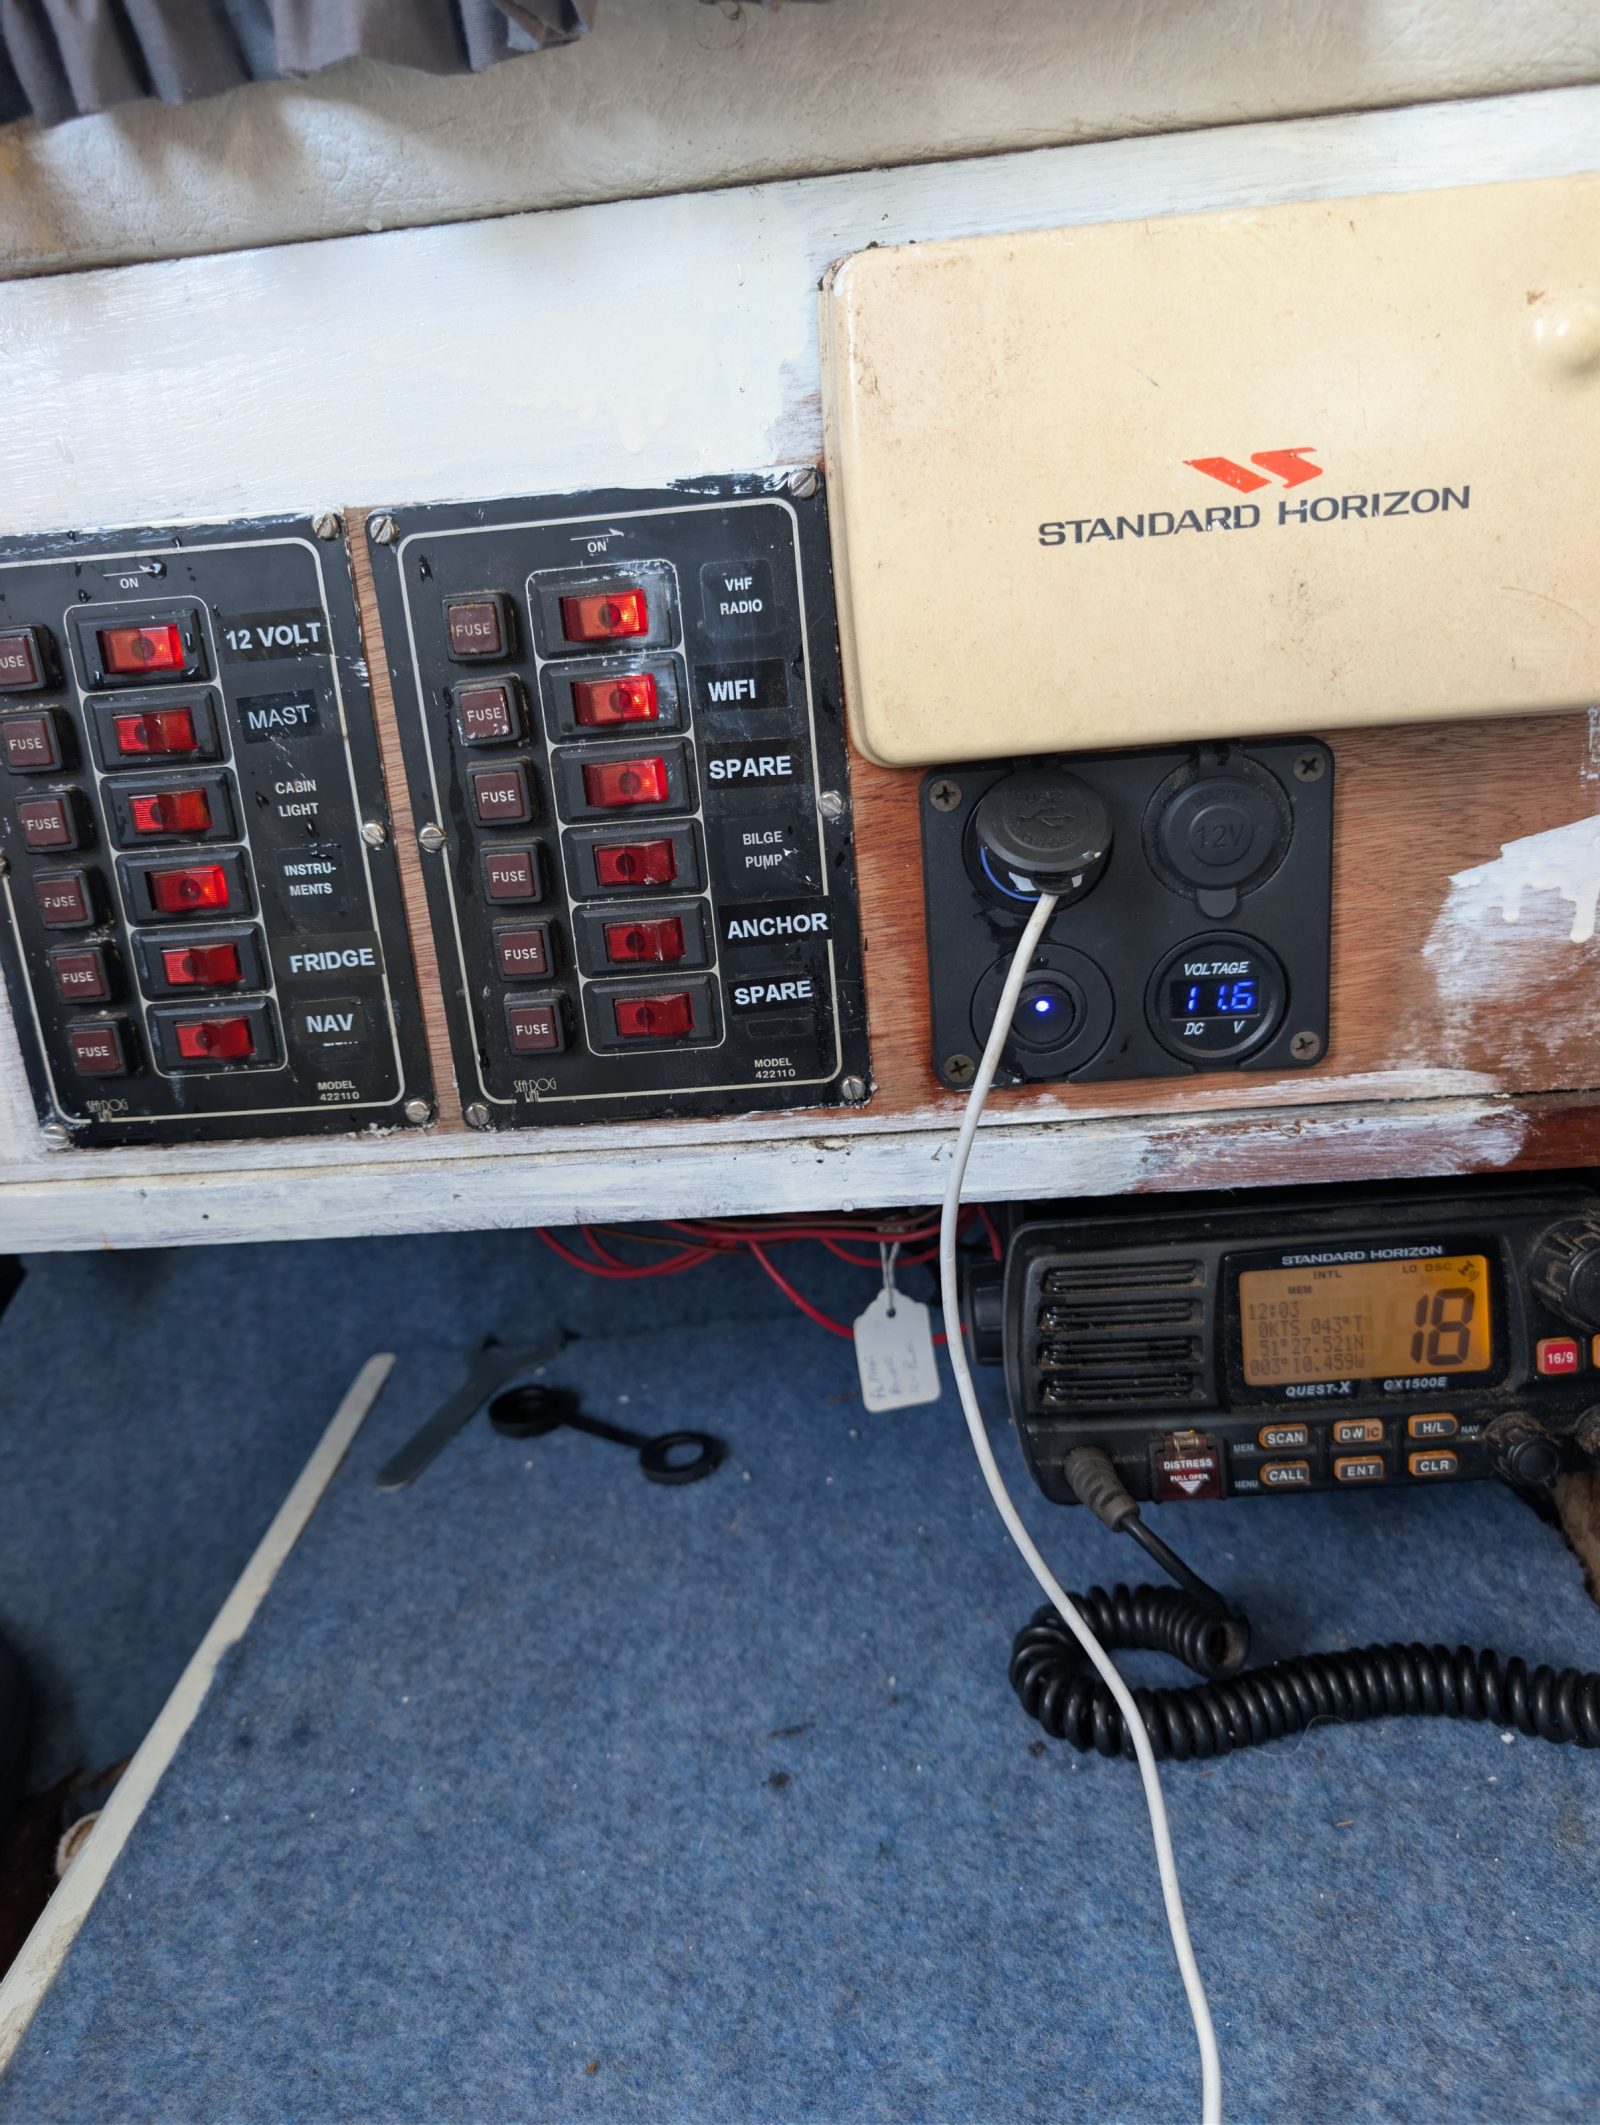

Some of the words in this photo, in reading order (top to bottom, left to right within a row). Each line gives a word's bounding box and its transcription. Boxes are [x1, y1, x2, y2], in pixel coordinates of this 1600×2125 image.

[1038, 504, 1260, 546] STANDARD
[1278, 486, 1470, 526] HORIZON
[587, 541, 607, 553] ON
[120, 577, 139, 590] ON
[725, 577, 752, 591] VHF
[720, 600, 762, 615] RADIO
[456, 622, 490, 636] FUSE
[226, 630, 251, 651] 12
[258, 622, 321, 648] VOLT
[0, 655, 25, 668] USE
[708, 679, 755, 701] WIFI
[247, 705, 311, 730] MAST
[467, 707, 501, 721] FUSE
[9, 737, 44, 750] FUSE
[709, 756, 791, 779] SPARE
[275, 780, 316, 794] CABIN
[481, 789, 515, 803] FUSE
[279, 802, 319, 818] LIGHT
[27, 817, 60, 831] FUSE
[742, 831, 783, 846] BILGE
[1196, 823, 1245, 848] 12V
[745, 853, 783, 868] PUMP
[284, 863, 336, 877] INSTRU-
[492, 870, 526, 883] FUSE
[289, 883, 333, 896] MENTS
[45, 895, 76, 908] FUSE
[727, 912, 828, 939] ANCHOR
[289, 948, 375, 973] FRIDGE
[505, 947, 538, 960] FUSE
[1184, 961, 1249, 976] VOLTAGE
[62, 970, 94, 984] FUSE
[734, 981, 813, 1006] SPARE
[306, 1013, 354, 1033] NAV
[516, 1022, 549, 1036] FUSE
[1184, 1022, 1205, 1035] DC
[1233, 1020, 1245, 1034] V
[78, 1045, 109, 1058] FUSE
[754, 1057, 792, 1068] MODEL
[755, 1068, 796, 1079] 422110
[317, 1080, 356, 1091] MODEL
[320, 1091, 360, 1102] 422110
[1282, 1250, 1365, 1266] STANDARD
[1370, 1245, 1443, 1261] HORIZON
[1313, 1270, 1342, 1280] INTL
[1402, 1264, 1417, 1273] LO
[1425, 1262, 1452, 1272] DSC
[1288, 1285, 1312, 1295] MEM
[1248, 1300, 1300, 1320] 12:03
[1411, 1287, 1475, 1366] 18
[1547, 1351, 1574, 1365] 16/9
[1285, 1380, 1350, 1398] QUEST-X
[1383, 1376, 1447, 1391] GX1500E
[1341, 1428, 1364, 1440] DW
[1422, 1422, 1445, 1435] H/L
[1461, 1424, 1480, 1434] NAV
[1267, 1431, 1304, 1445] SCAN
[1233, 1443, 1254, 1452] MEM
[1164, 1458, 1214, 1470] DISTRESS
[1346, 1464, 1376, 1477] ENT
[1420, 1459, 1450, 1472] CLR
[1170, 1474, 1187, 1482] PULL
[1188, 1472, 1208, 1480] OPEN
[1269, 1469, 1304, 1482] CALL
[1234, 1480, 1258, 1489] MENU
